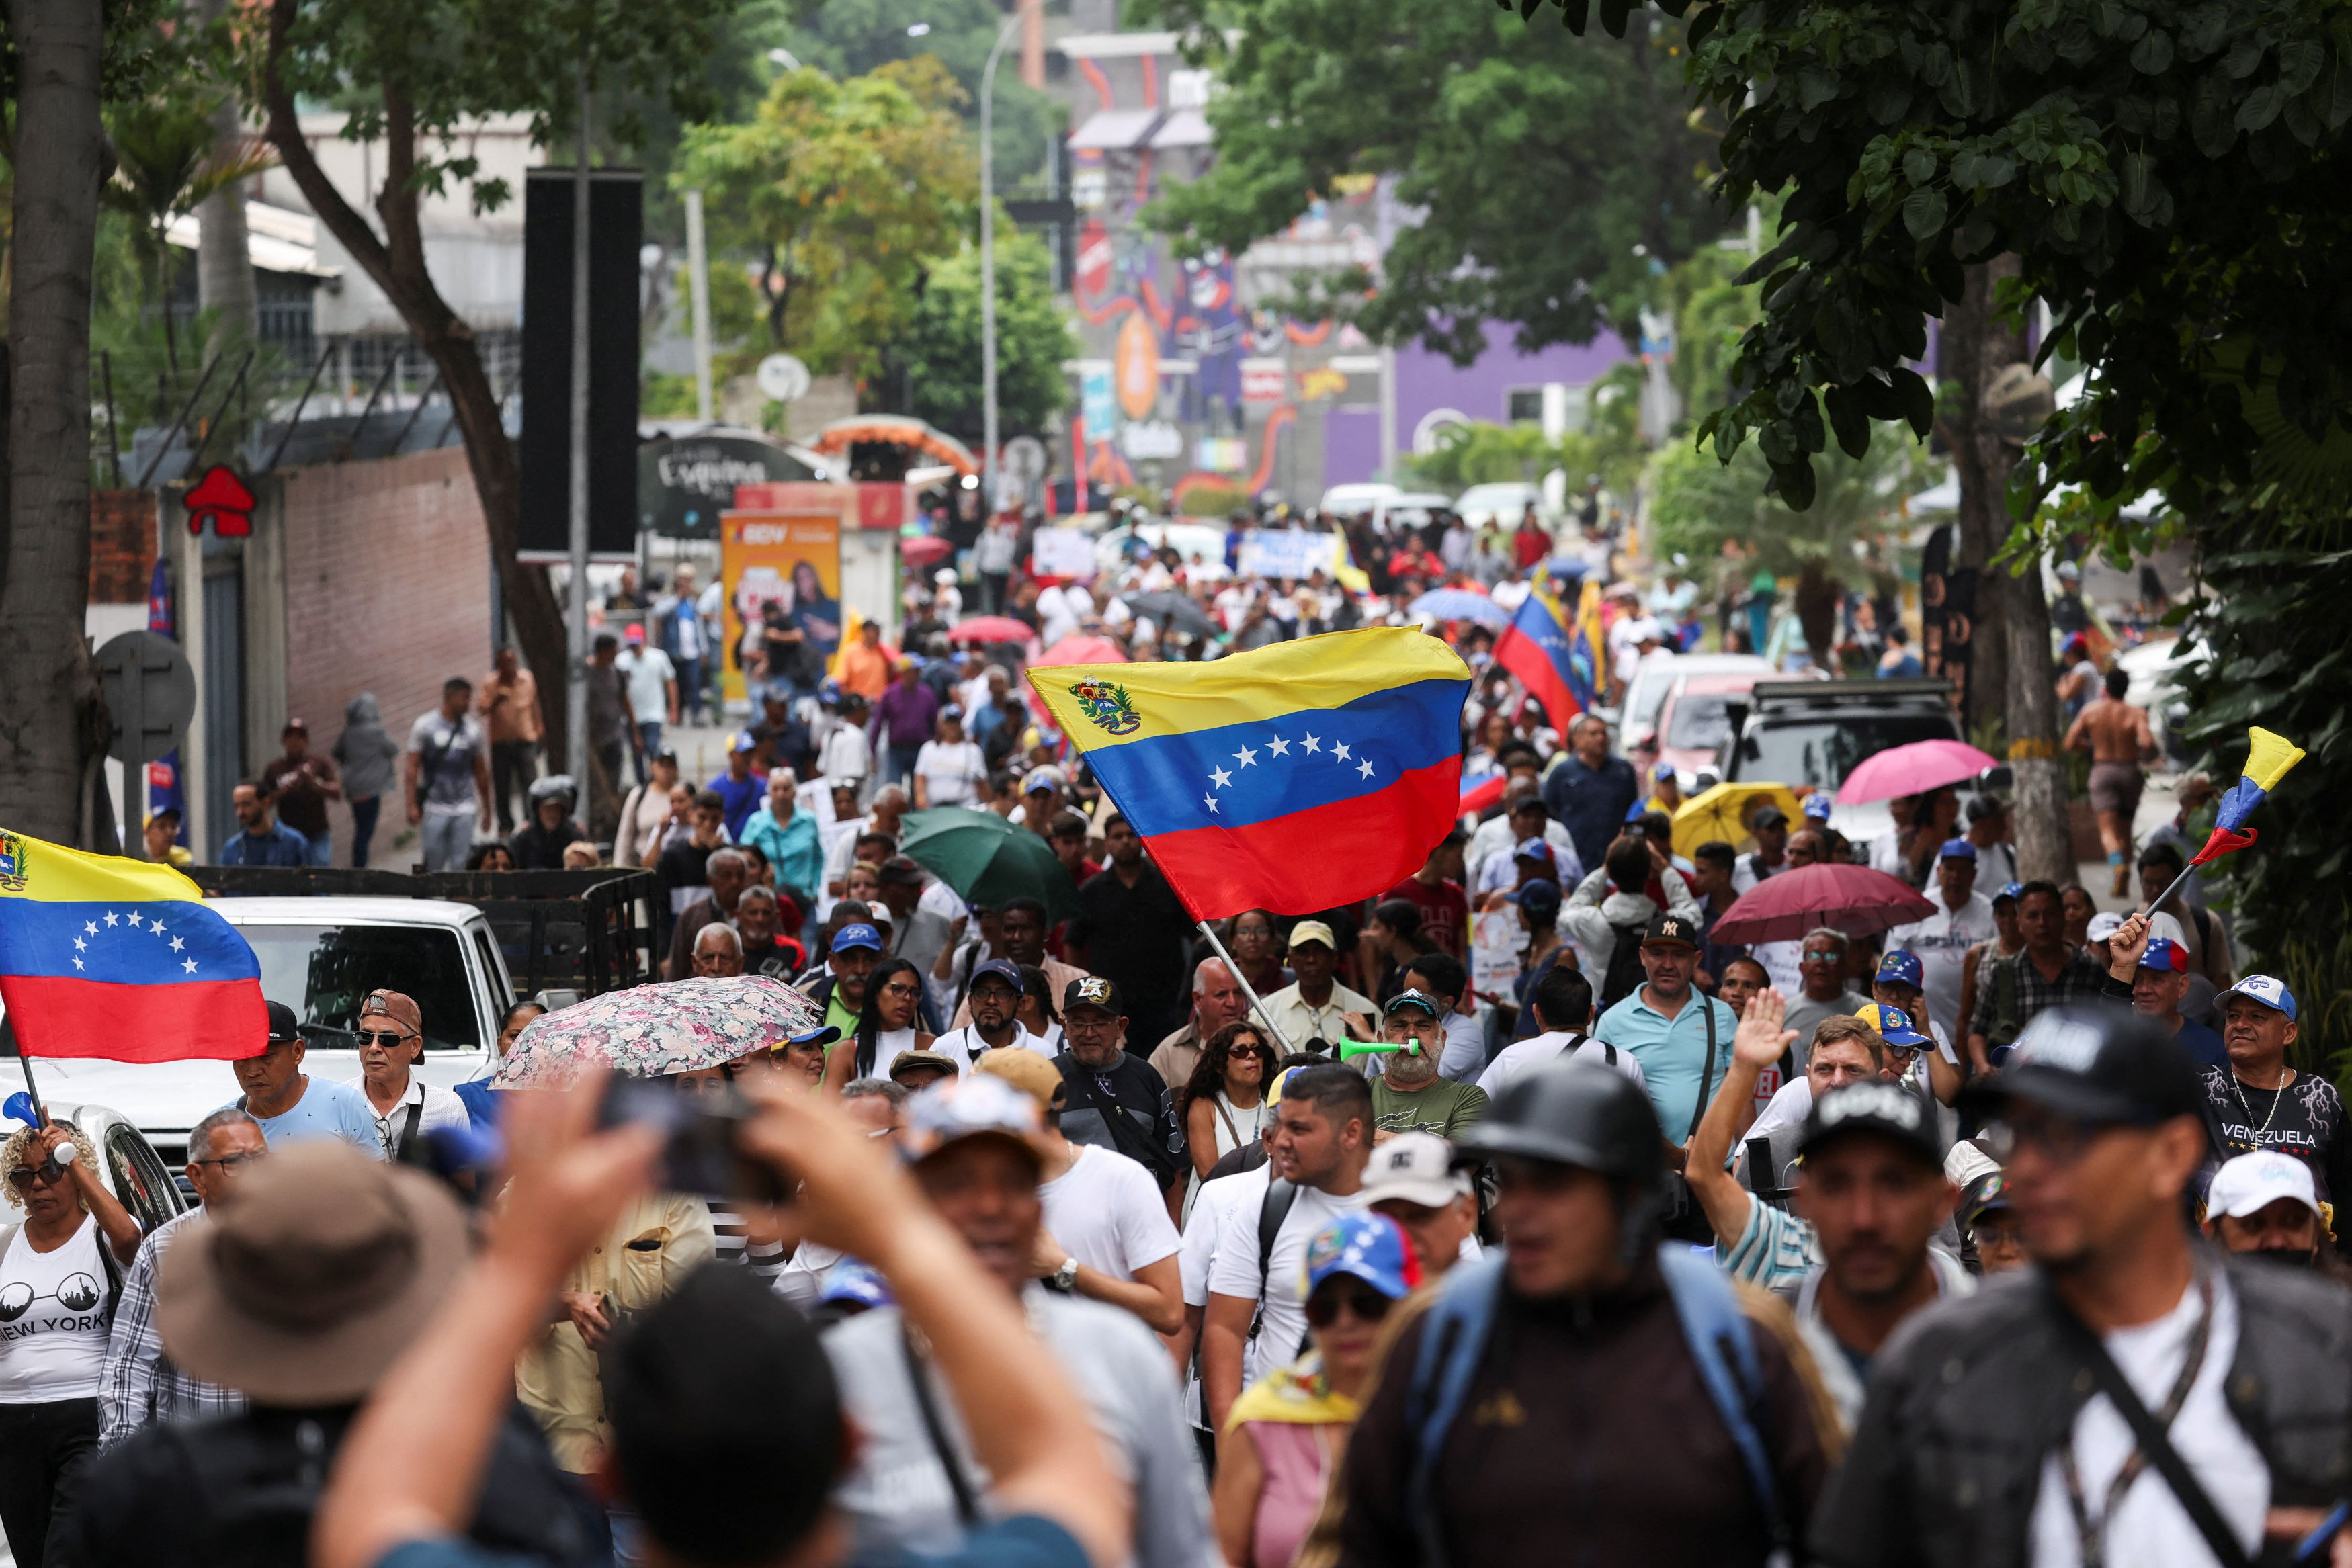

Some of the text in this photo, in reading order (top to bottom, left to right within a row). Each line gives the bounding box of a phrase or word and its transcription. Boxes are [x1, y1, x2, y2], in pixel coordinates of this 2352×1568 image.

[2222, 1123, 2316, 1148] VENEZUELA
[0, 1312, 105, 1342] NEW YORK
